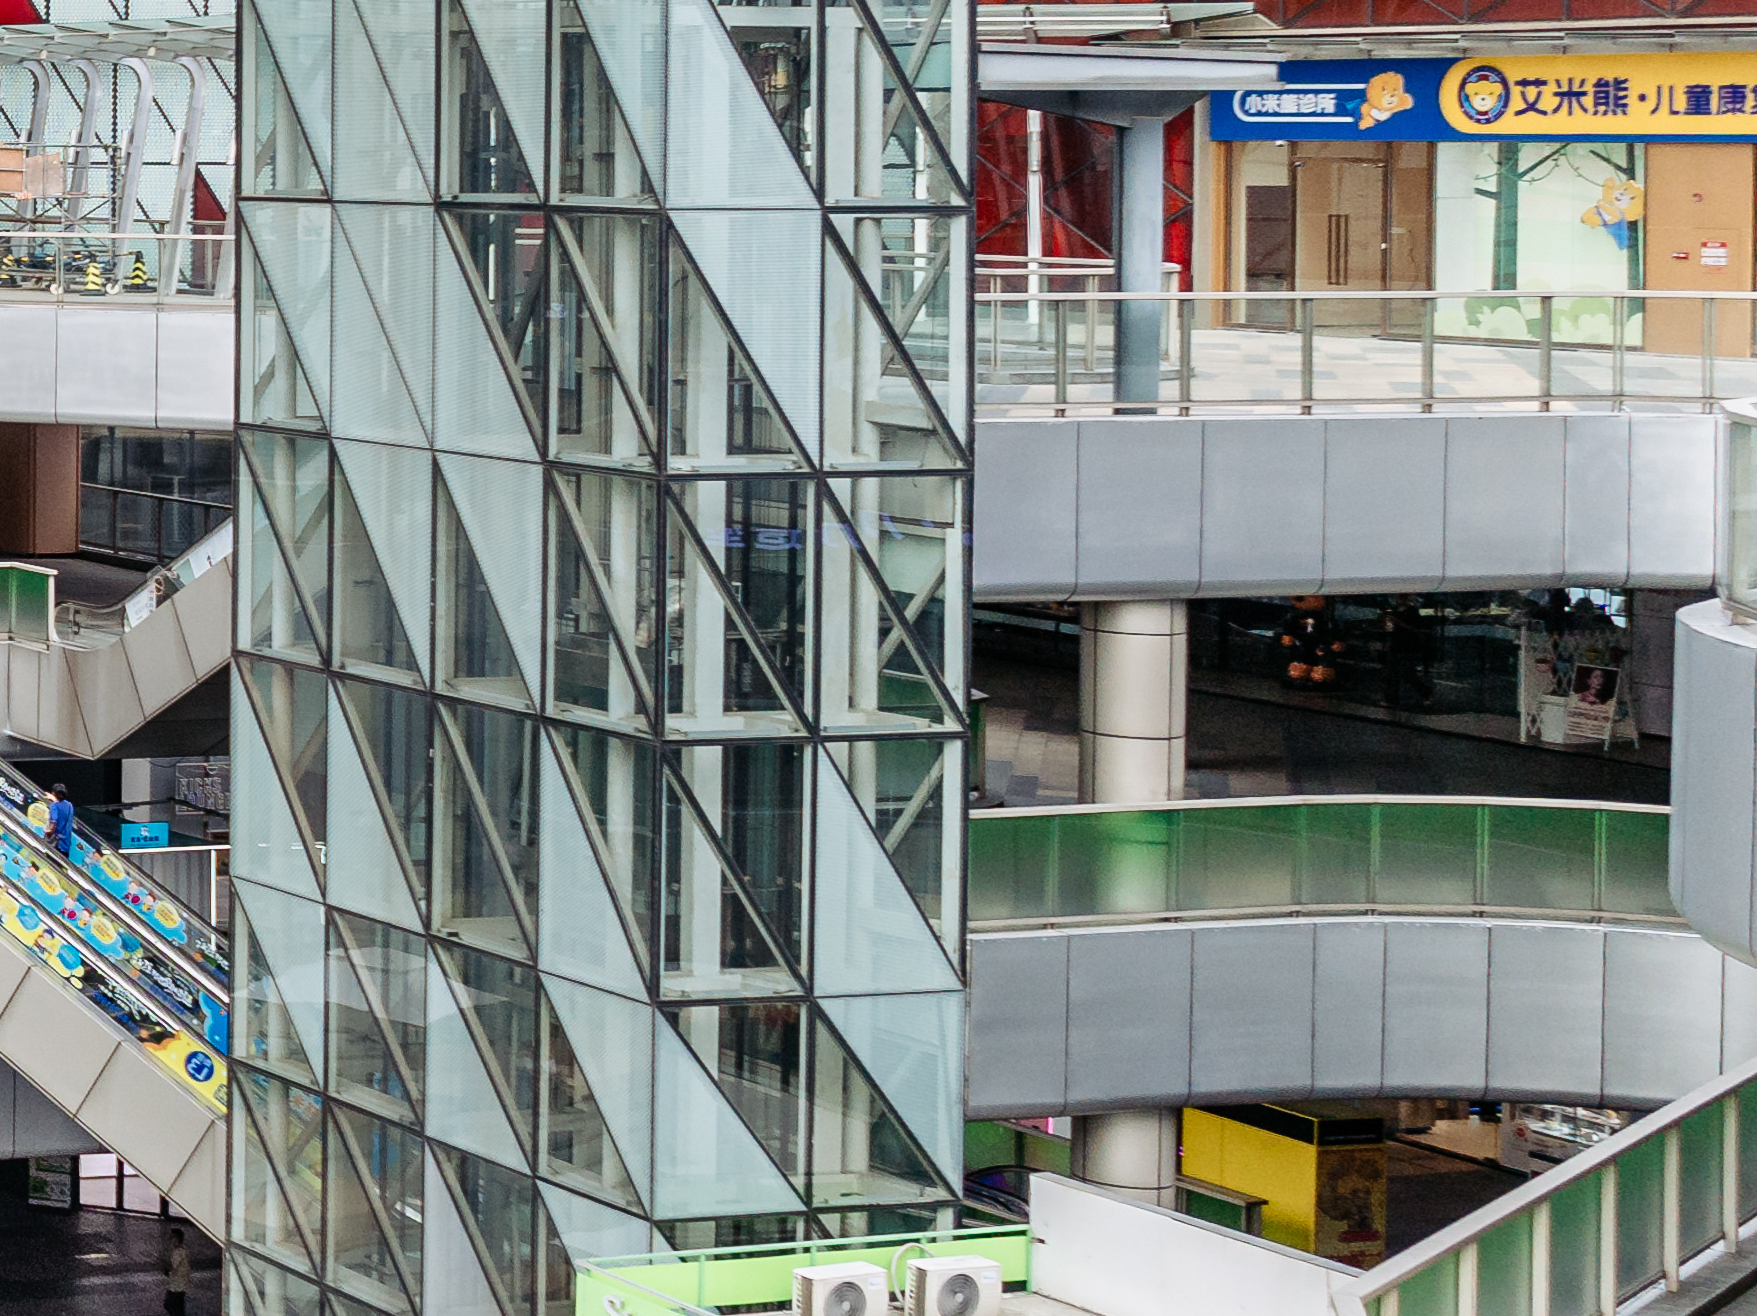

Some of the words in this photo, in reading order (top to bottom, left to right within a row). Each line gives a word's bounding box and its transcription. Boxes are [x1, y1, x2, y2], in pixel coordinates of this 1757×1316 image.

[1513, 77, 1757, 118] 艾米熊·儿童康
